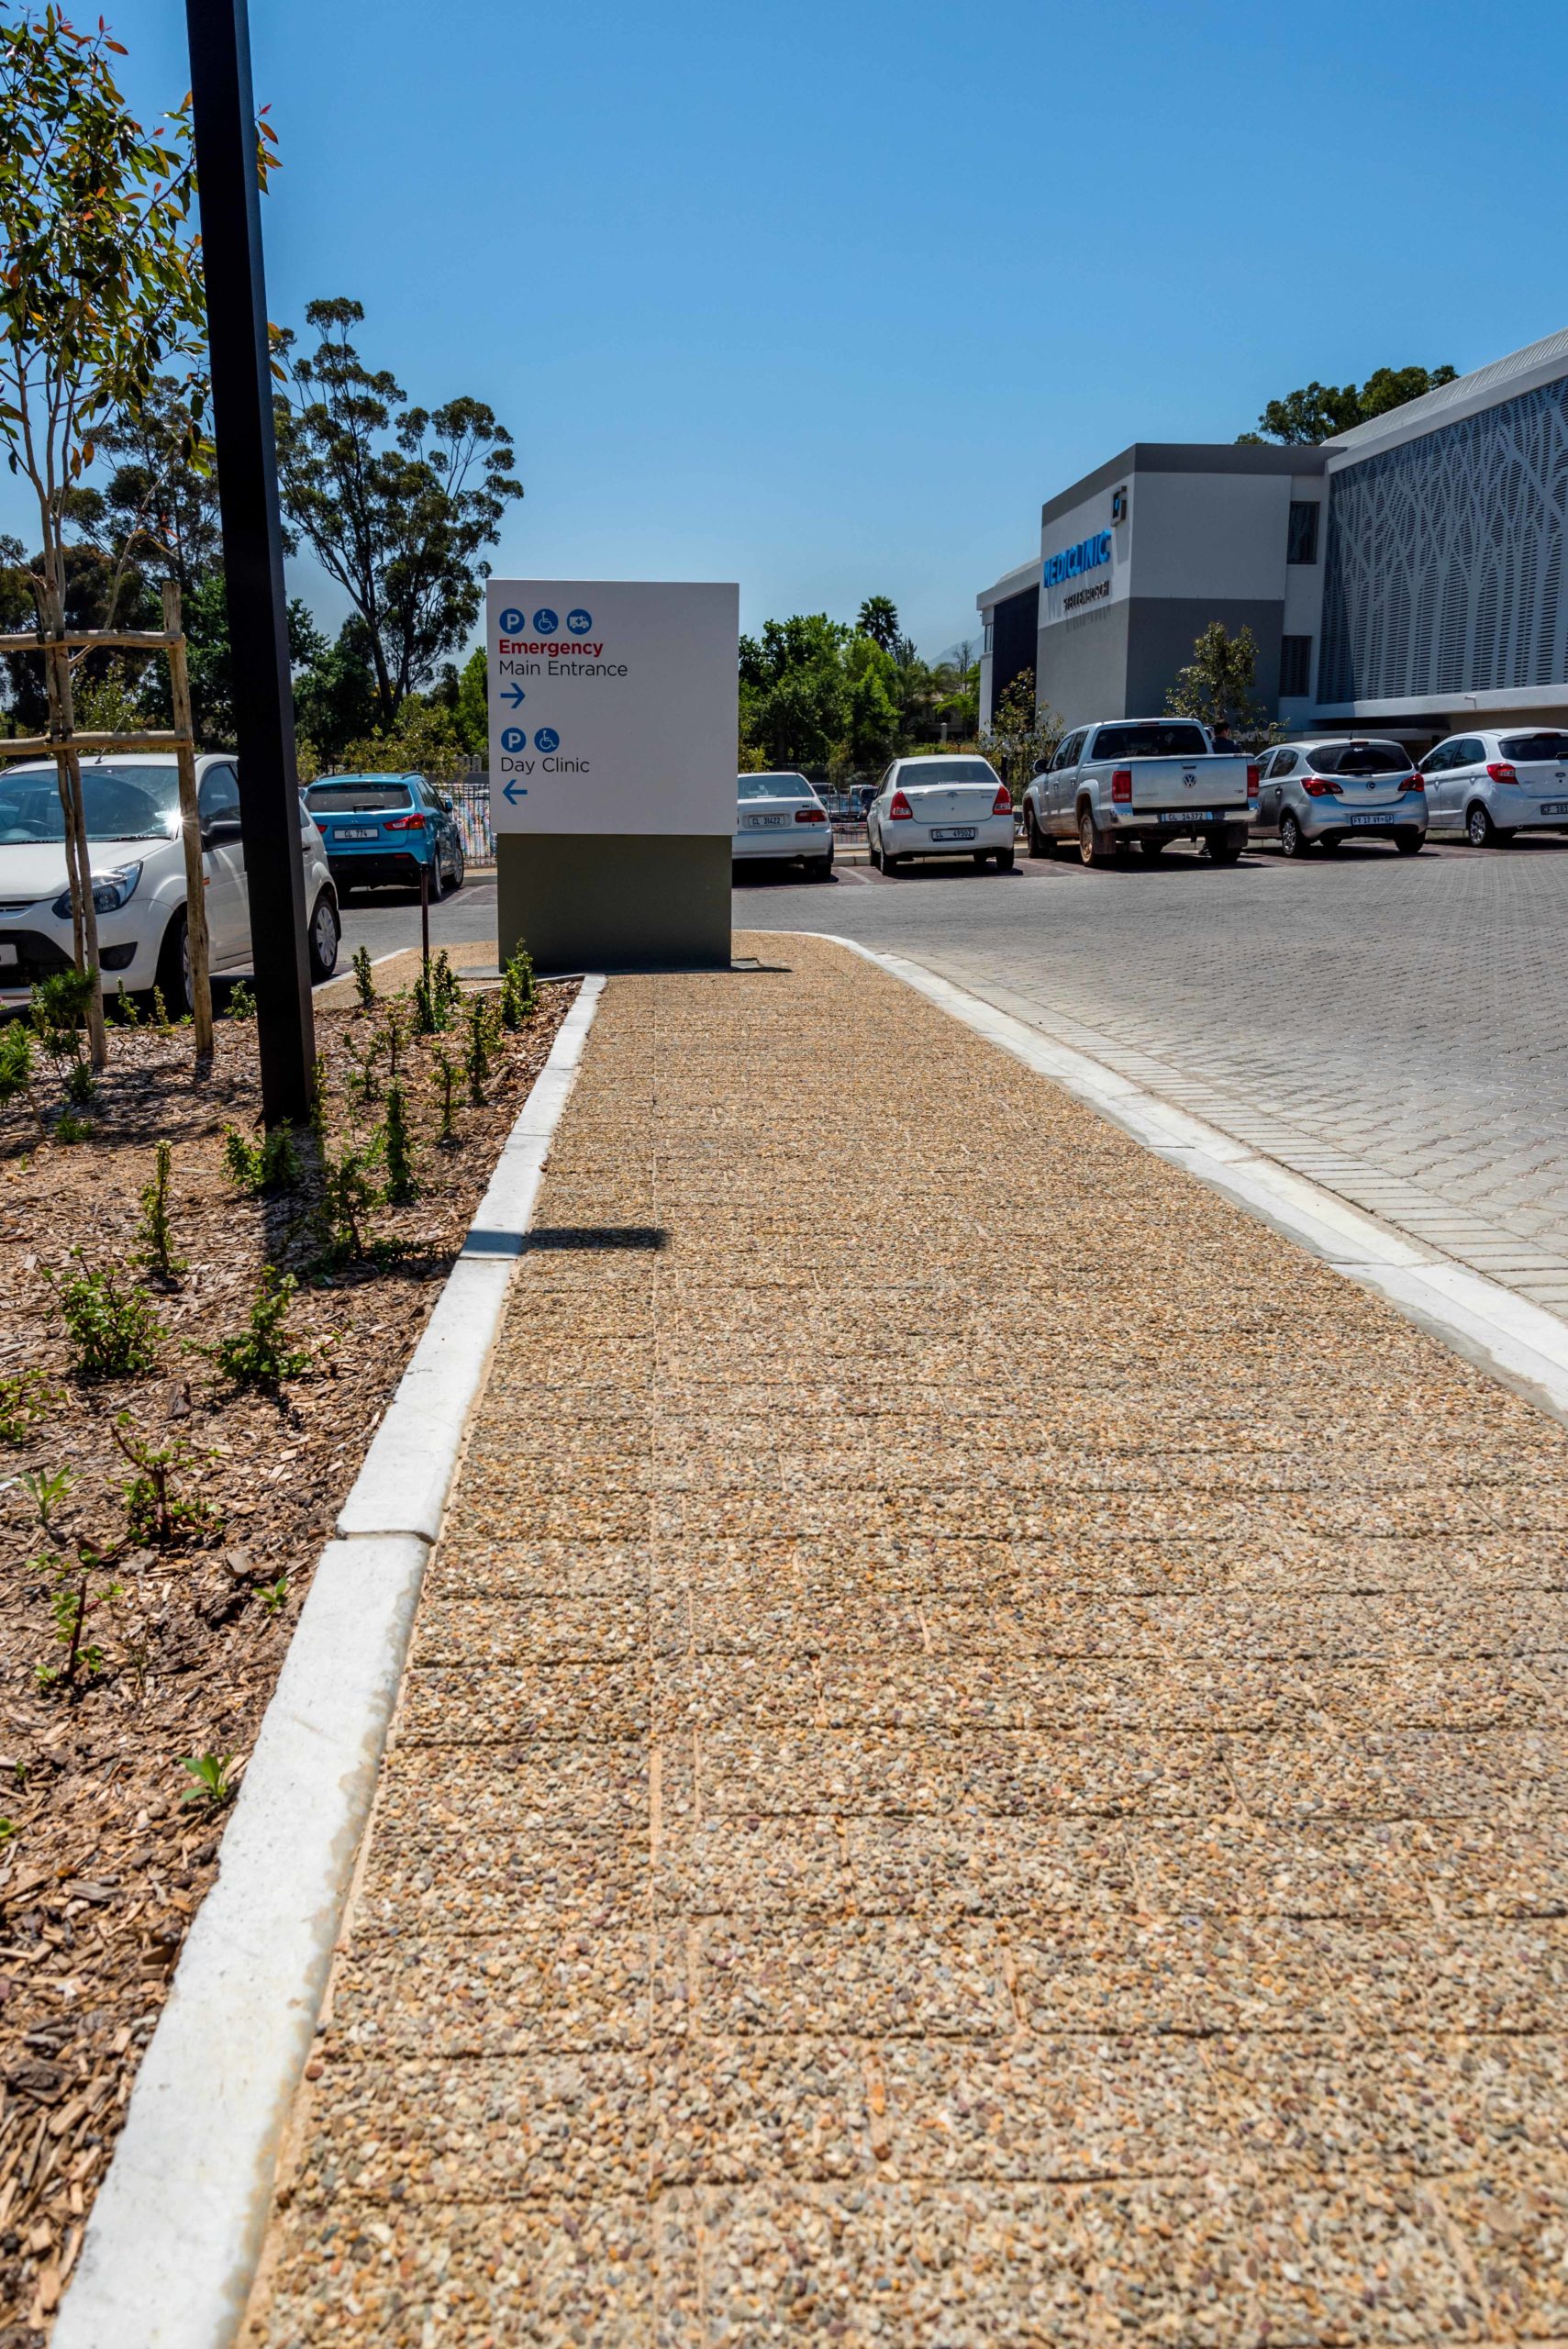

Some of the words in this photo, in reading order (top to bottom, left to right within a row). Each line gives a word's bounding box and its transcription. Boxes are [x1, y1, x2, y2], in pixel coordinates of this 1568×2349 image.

[1043, 529, 1112, 588] MEDICLINIC
[506, 613, 520, 630] P
[499, 640, 603, 657] Emergency
[499, 660, 540, 675] Main
[548, 661, 628, 676] Entrance
[508, 732, 521, 749] P
[501, 757, 536, 774] Day
[542, 757, 590, 773] Clinic
[752, 817, 761, 825] CL
[763, 816, 781, 825] 31422
[1168, 813, 1177, 821] CL
[1182, 812, 1203, 820] 14372
[344, 829, 353, 838] CL
[356, 829, 368, 837] 774
